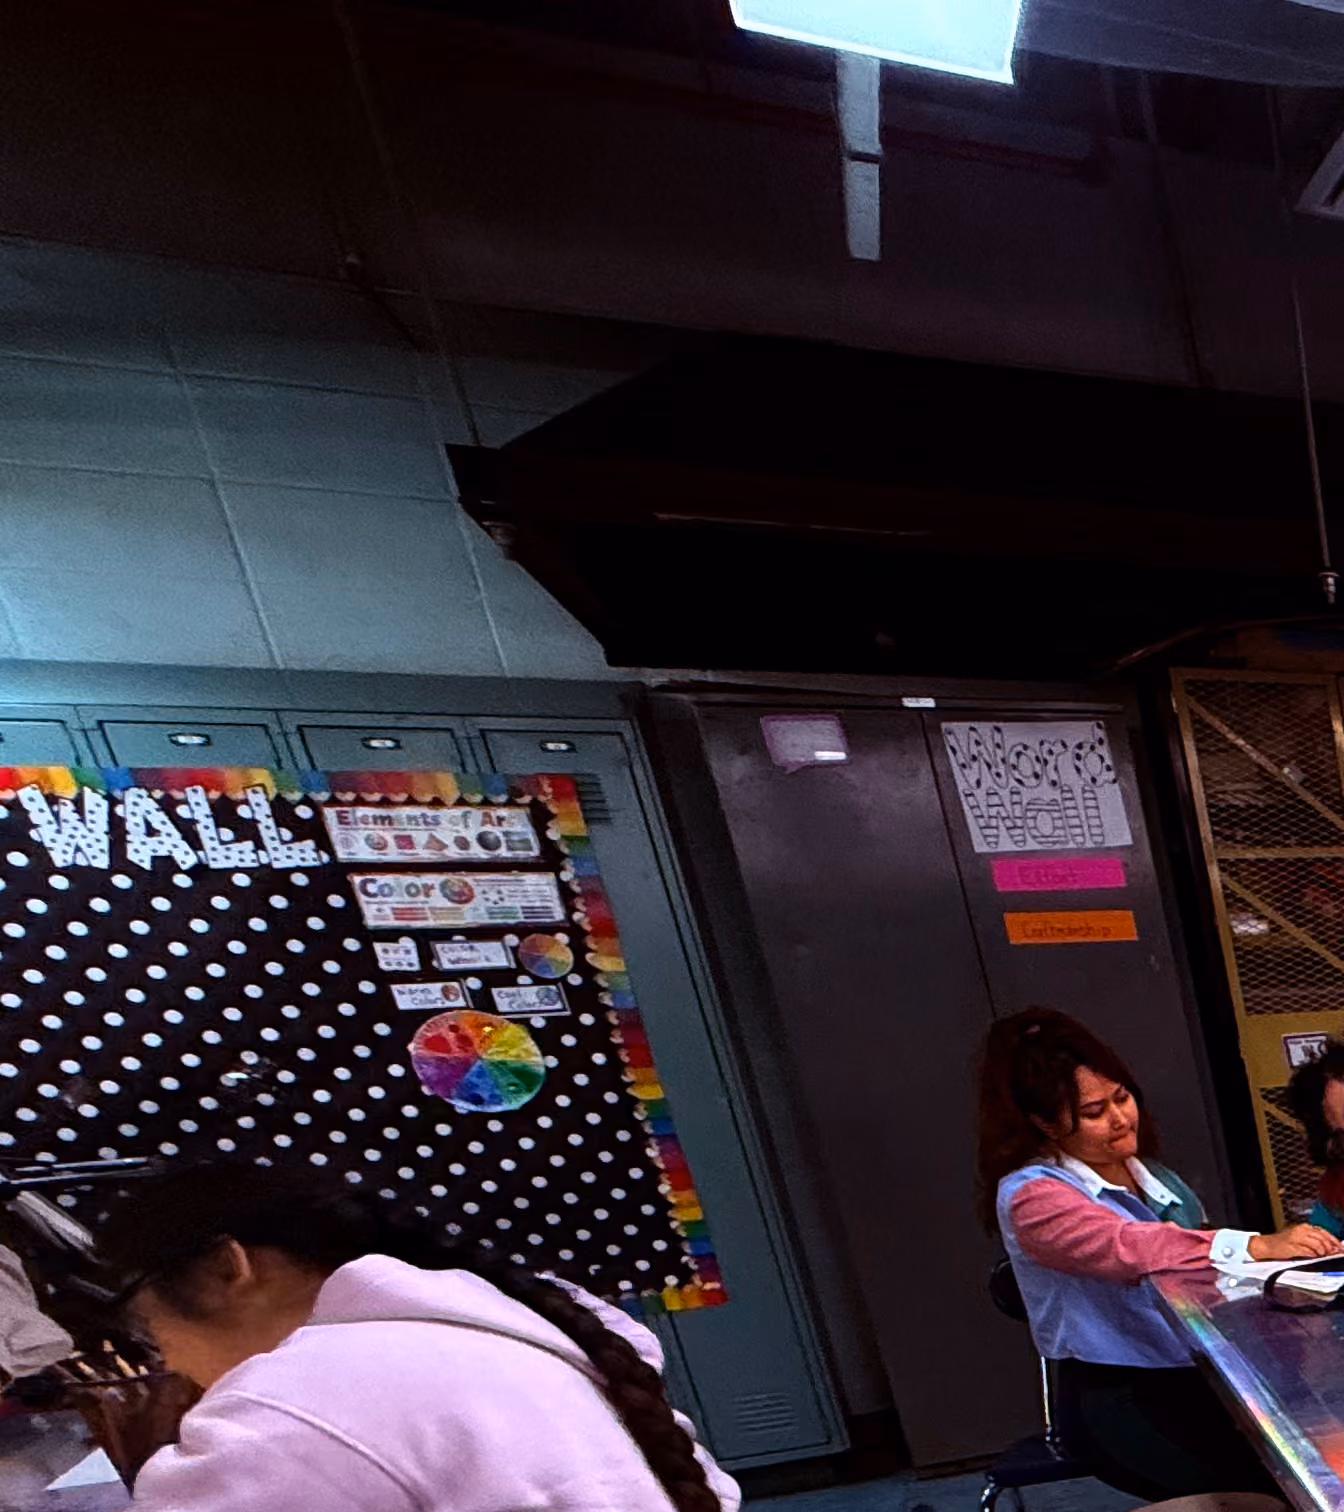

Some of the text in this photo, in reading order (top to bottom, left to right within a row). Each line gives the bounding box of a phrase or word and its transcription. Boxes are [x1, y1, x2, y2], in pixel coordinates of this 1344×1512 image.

[945, 721, 1118, 790] Word
[17, 783, 322, 870] WALL
[336, 809, 441, 827] Elements
[962, 783, 1106, 848] Wall
[359, 877, 436, 899] Color
